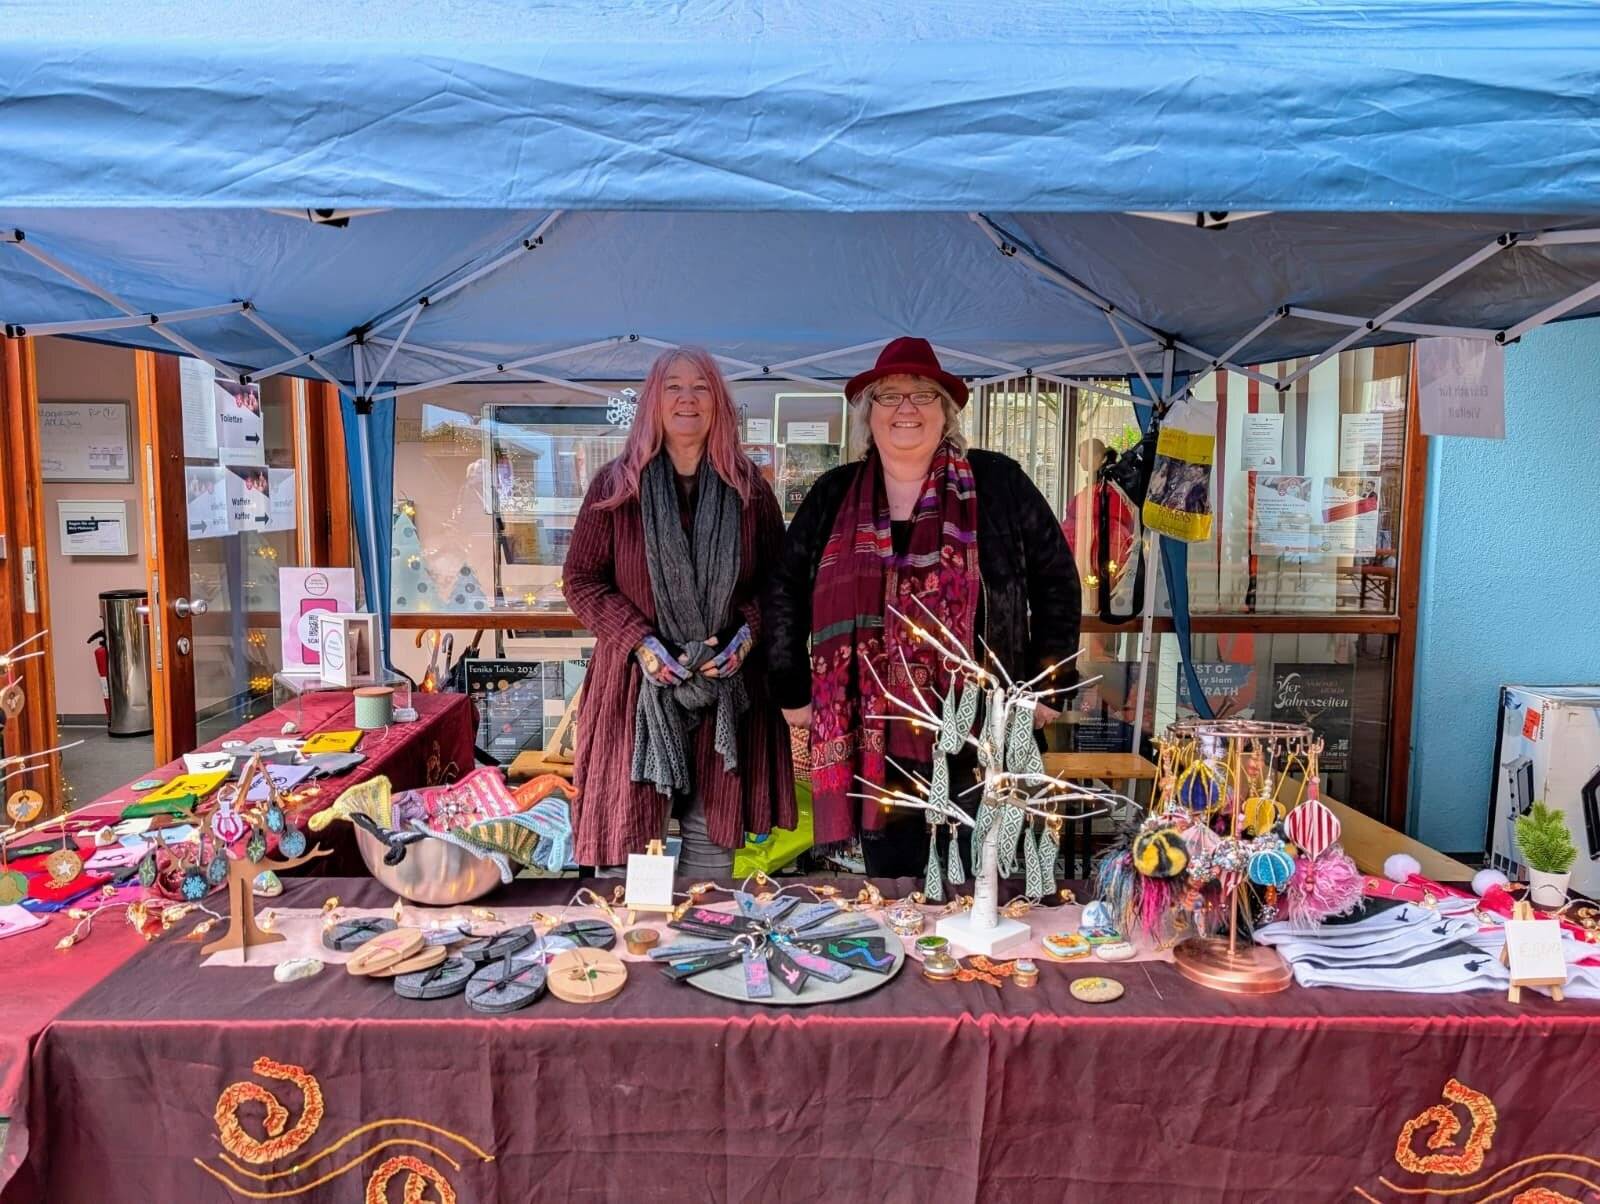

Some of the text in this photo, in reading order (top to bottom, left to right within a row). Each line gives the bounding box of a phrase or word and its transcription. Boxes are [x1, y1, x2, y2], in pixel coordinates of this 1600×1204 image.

[220, 413, 243, 424] Toiletten
[234, 511, 250, 521] Kaffee
[469, 665, 538, 674] Feniks Taiko 2025
[1215, 664, 1232, 674] OF
[1210, 676, 1232, 684] Slam
[1276, 673, 1301, 693] Vier
[1180, 686, 1239, 696] ERATH
[1274, 691, 1348, 709] Jahreszeiten
